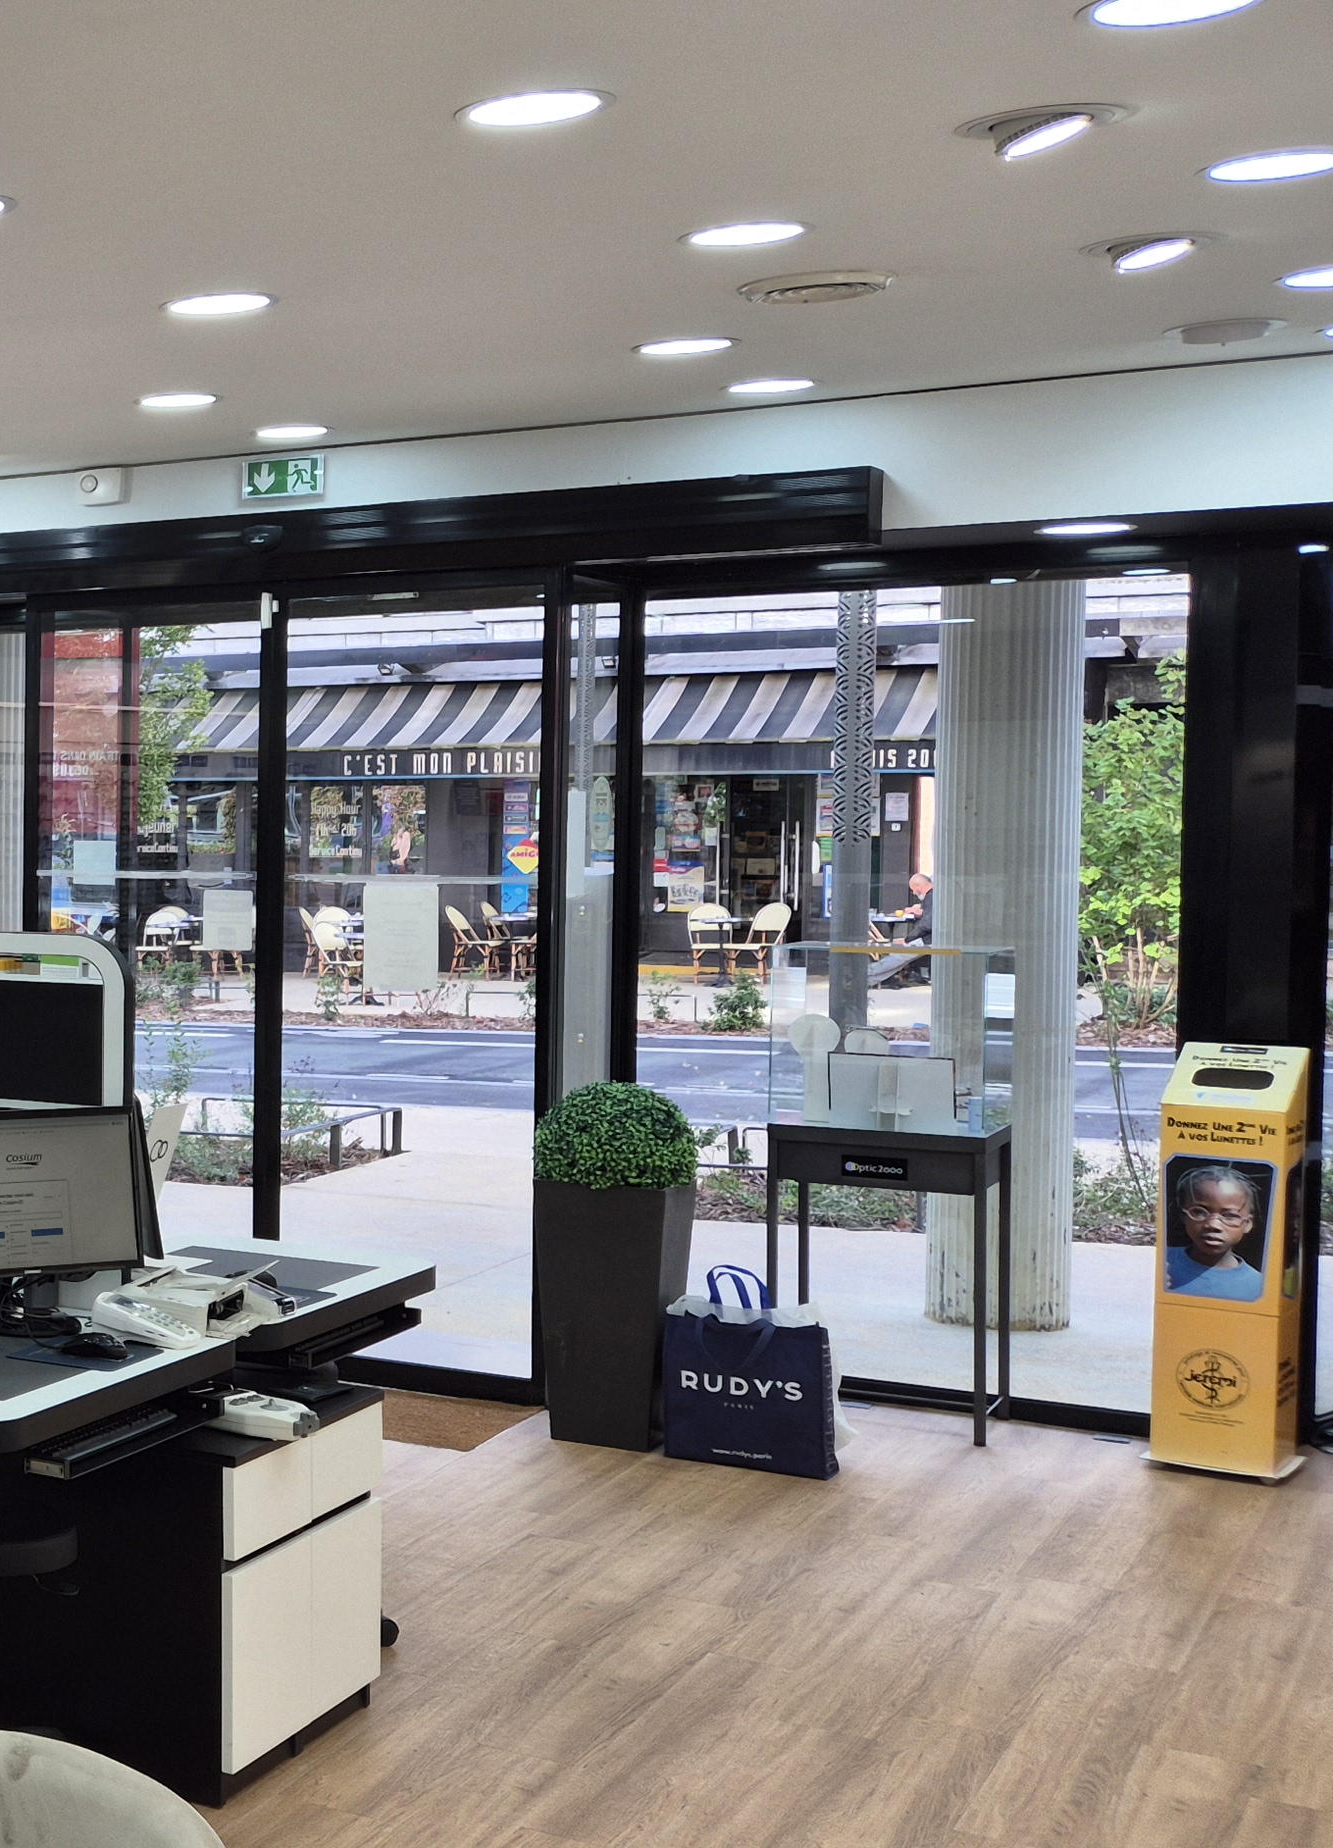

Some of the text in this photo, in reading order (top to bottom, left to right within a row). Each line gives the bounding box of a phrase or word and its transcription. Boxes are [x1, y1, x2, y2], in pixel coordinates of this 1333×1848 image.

[344, 753, 398, 777] C'EST
[413, 751, 452, 775] MON
[907, 748, 937, 768] 20
[681, 1369, 803, 1402] RUDY'S
